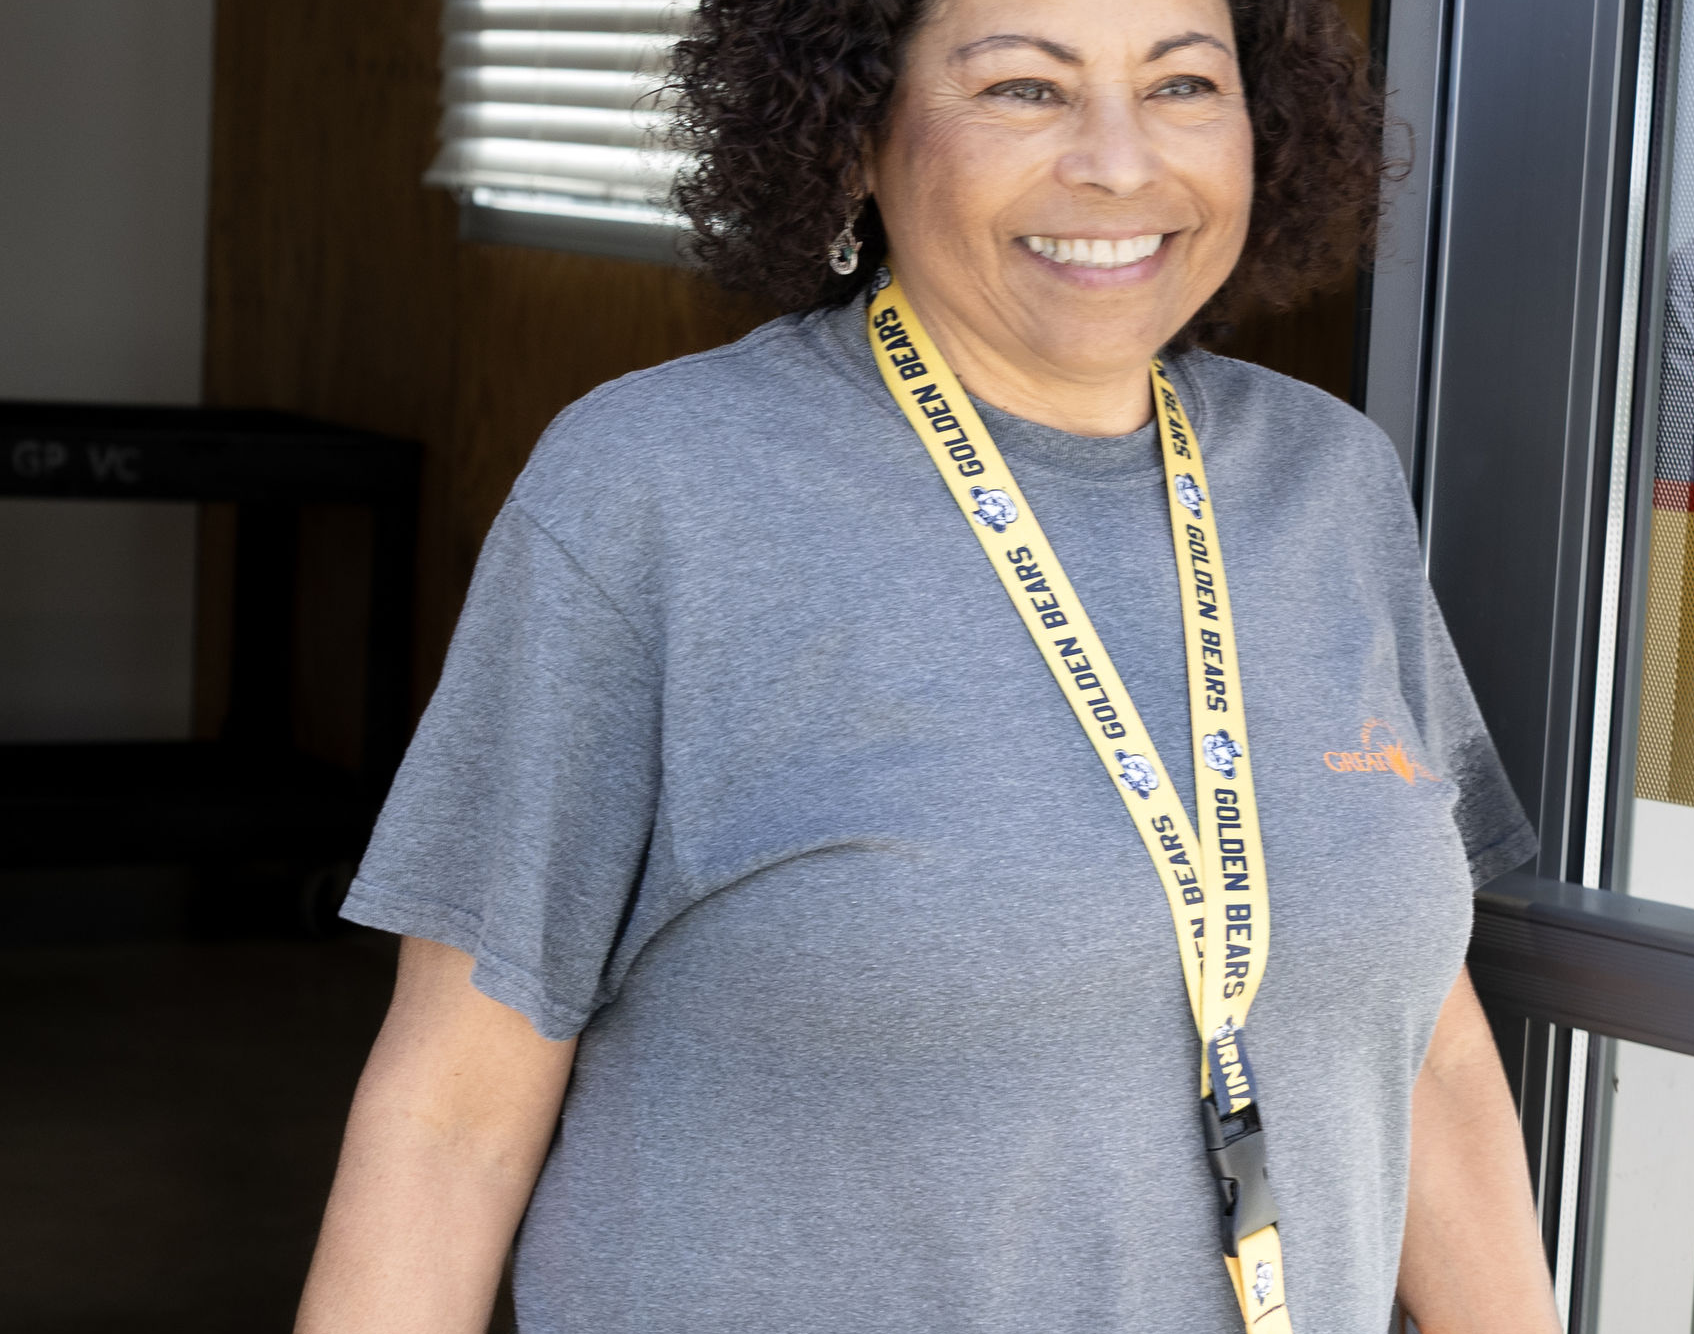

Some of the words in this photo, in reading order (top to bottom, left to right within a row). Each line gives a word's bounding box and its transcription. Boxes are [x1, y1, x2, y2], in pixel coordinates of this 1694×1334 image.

[873, 305, 928, 382] BEARS
[11, 439, 68, 478] GP
[85, 442, 142, 482] VC
[910, 383, 986, 478] GOLDEN
[1005, 545, 1069, 630] BEARS
[1186, 523, 1219, 622] GOLDEN
[1053, 635, 1127, 740] GOLDEN
[1200, 628, 1228, 713] BEARS
[1151, 813, 1205, 906] BEARS
[1214, 787, 1250, 892] GOLDEN
[1222, 903, 1252, 1001] BEARS
